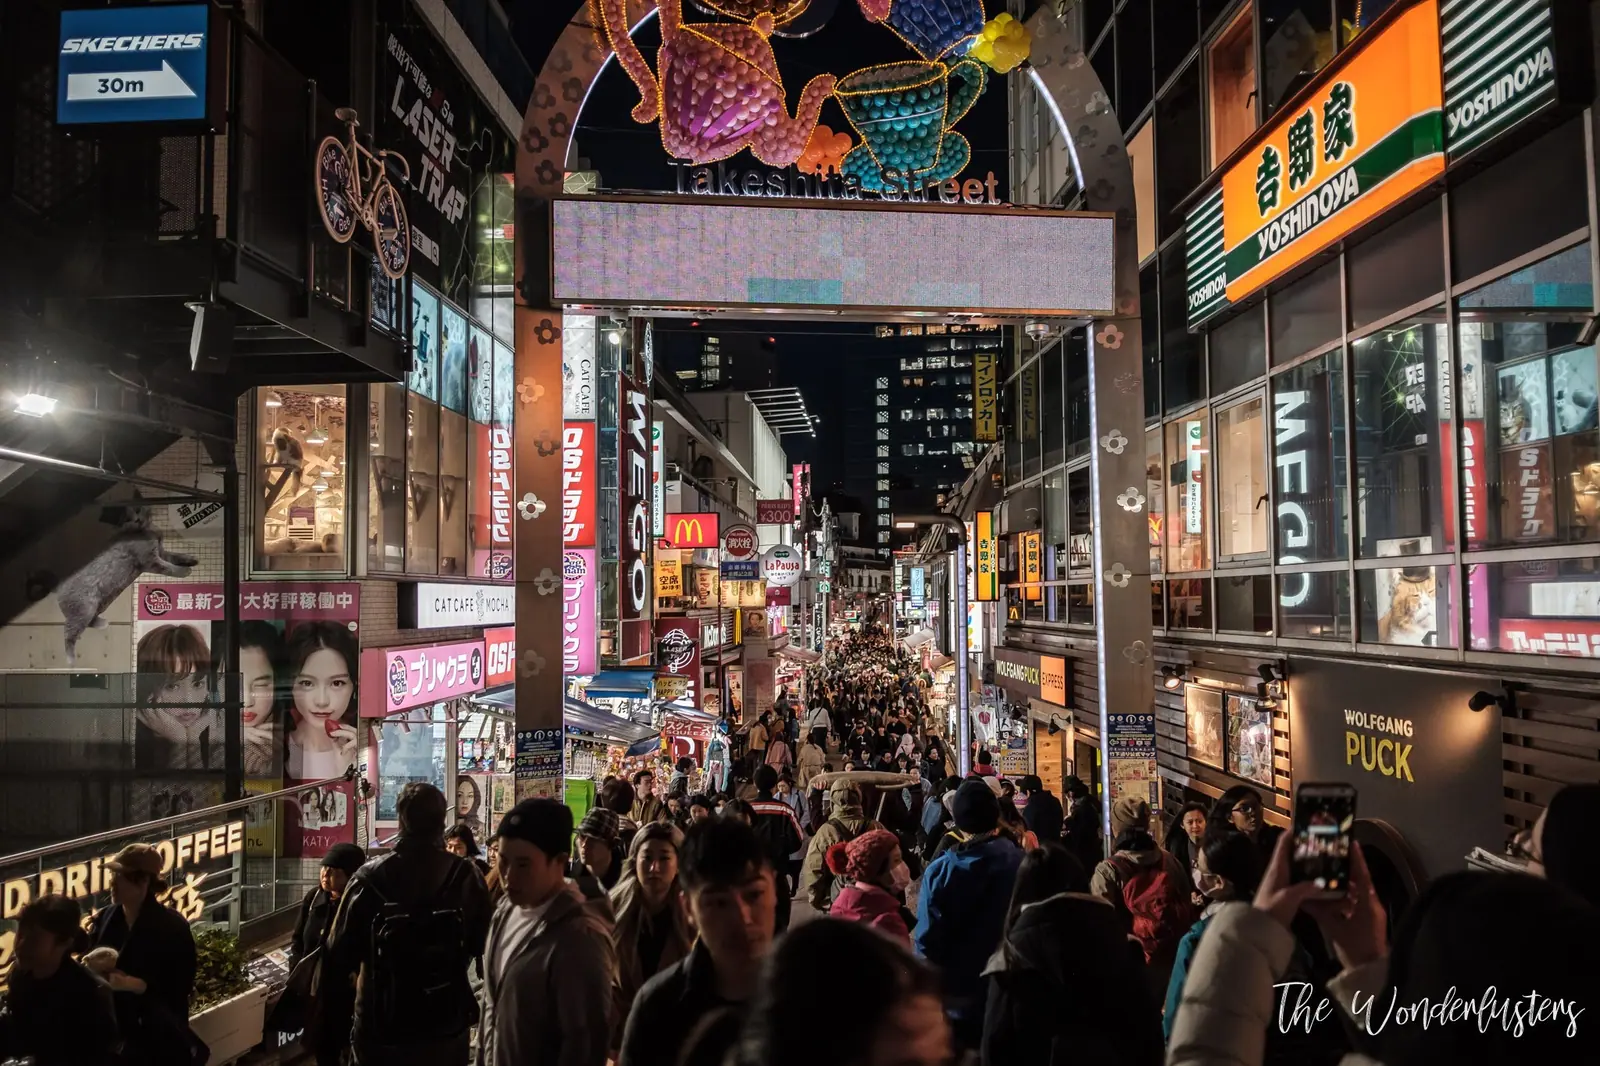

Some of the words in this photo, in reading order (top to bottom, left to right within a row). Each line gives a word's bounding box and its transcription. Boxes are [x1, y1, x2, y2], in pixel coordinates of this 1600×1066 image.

[61, 32, 204, 54] SKECHERS
[97, 77, 144, 94] 30m
[1448, 46, 1553, 138] YOSHINOYA
[391, 74, 456, 172] LASER
[1255, 81, 1357, 218] 吉野家
[418, 152, 468, 225] TRAP
[667, 159, 862, 201] Takeshita
[880, 166, 1001, 206] Street
[1258, 166, 1359, 260] YOSHINOYA
[581, 359, 592, 382] CAT
[581, 382, 592, 414] CAFE
[978, 354, 994, 431] コインロッカー
[625, 390, 647, 612] WEGO
[761, 510, 791, 522] ¥300
[728, 537, 751, 549] 消火栓
[980, 539, 989, 573] 吉野家
[765, 560, 775, 571] La
[776, 559, 799, 572] Pausa
[434, 597, 452, 612] CAT
[454, 597, 474, 612] CAFE
[486, 597, 510, 612] MOCHA
[996, 660, 1024, 682] WOLFGANG
[1024, 667, 1040, 686] PUCK
[1042, 672, 1064, 690] EXPRESS
[1344, 708, 1413, 737] WOLFGANG
[1346, 731, 1415, 783] PUCK
[156, 821, 244, 874] OFFEE
